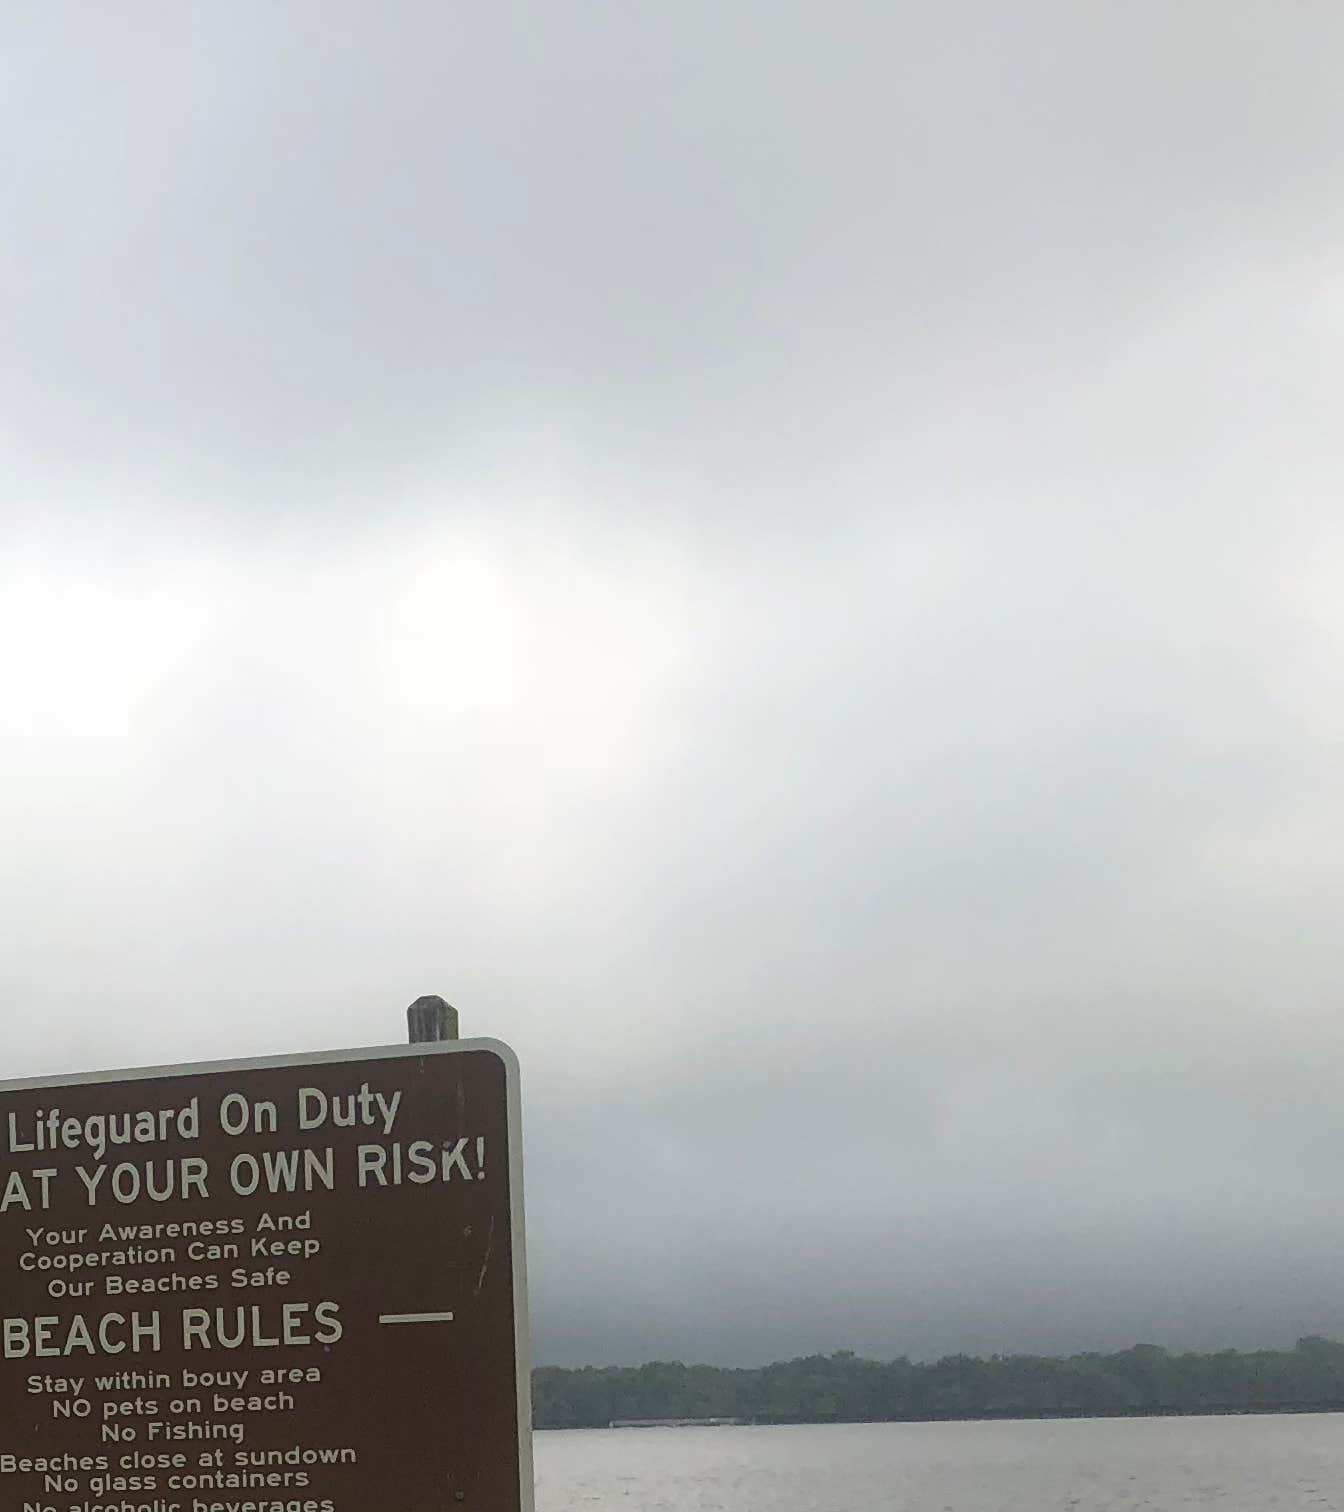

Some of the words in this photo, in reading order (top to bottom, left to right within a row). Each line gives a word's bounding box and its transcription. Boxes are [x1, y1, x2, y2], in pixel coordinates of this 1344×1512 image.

[8, 1095, 199, 1161] Lifeguard
[219, 1092, 277, 1136] On
[298, 1082, 403, 1135] Duty
[0, 1168, 58, 1213] AT
[74, 1157, 210, 1206] YOUR
[230, 1147, 334, 1196] OWN
[357, 1136, 486, 1187] RISK!
[25, 1227, 88, 1247] Your
[98, 1218, 245, 1242] Awareness
[256, 1209, 311, 1232] And
[19, 1245, 176, 1273] Cooperation
[187, 1241, 239, 1261] Can
[251, 1237, 320, 1259] Keep
[47, 1279, 95, 1298] Our
[105, 1272, 219, 1295] Beaches
[231, 1266, 291, 1288] Safe
[3, 1310, 161, 1359] BEACH
[182, 1301, 343, 1352] RULES
[27, 1374, 85, 1397] Stay
[94, 1369, 171, 1391] within
[182, 1368, 249, 1390] bouy
[260, 1367, 321, 1384] area
[103, 1396, 159, 1421] pets
[169, 1398, 201, 1414] on
[213, 1391, 294, 1412] beach
[101, 1423, 137, 1442] No
[148, 1420, 244, 1444] Fishing
[0, 1452, 109, 1473] Beaches
[119, 1450, 187, 1470] close
[198, 1448, 224, 1467] at
[234, 1445, 357, 1466] sundown
[44, 1474, 79, 1493] No
[89, 1472, 157, 1498] glass
[167, 1468, 310, 1490] containers
